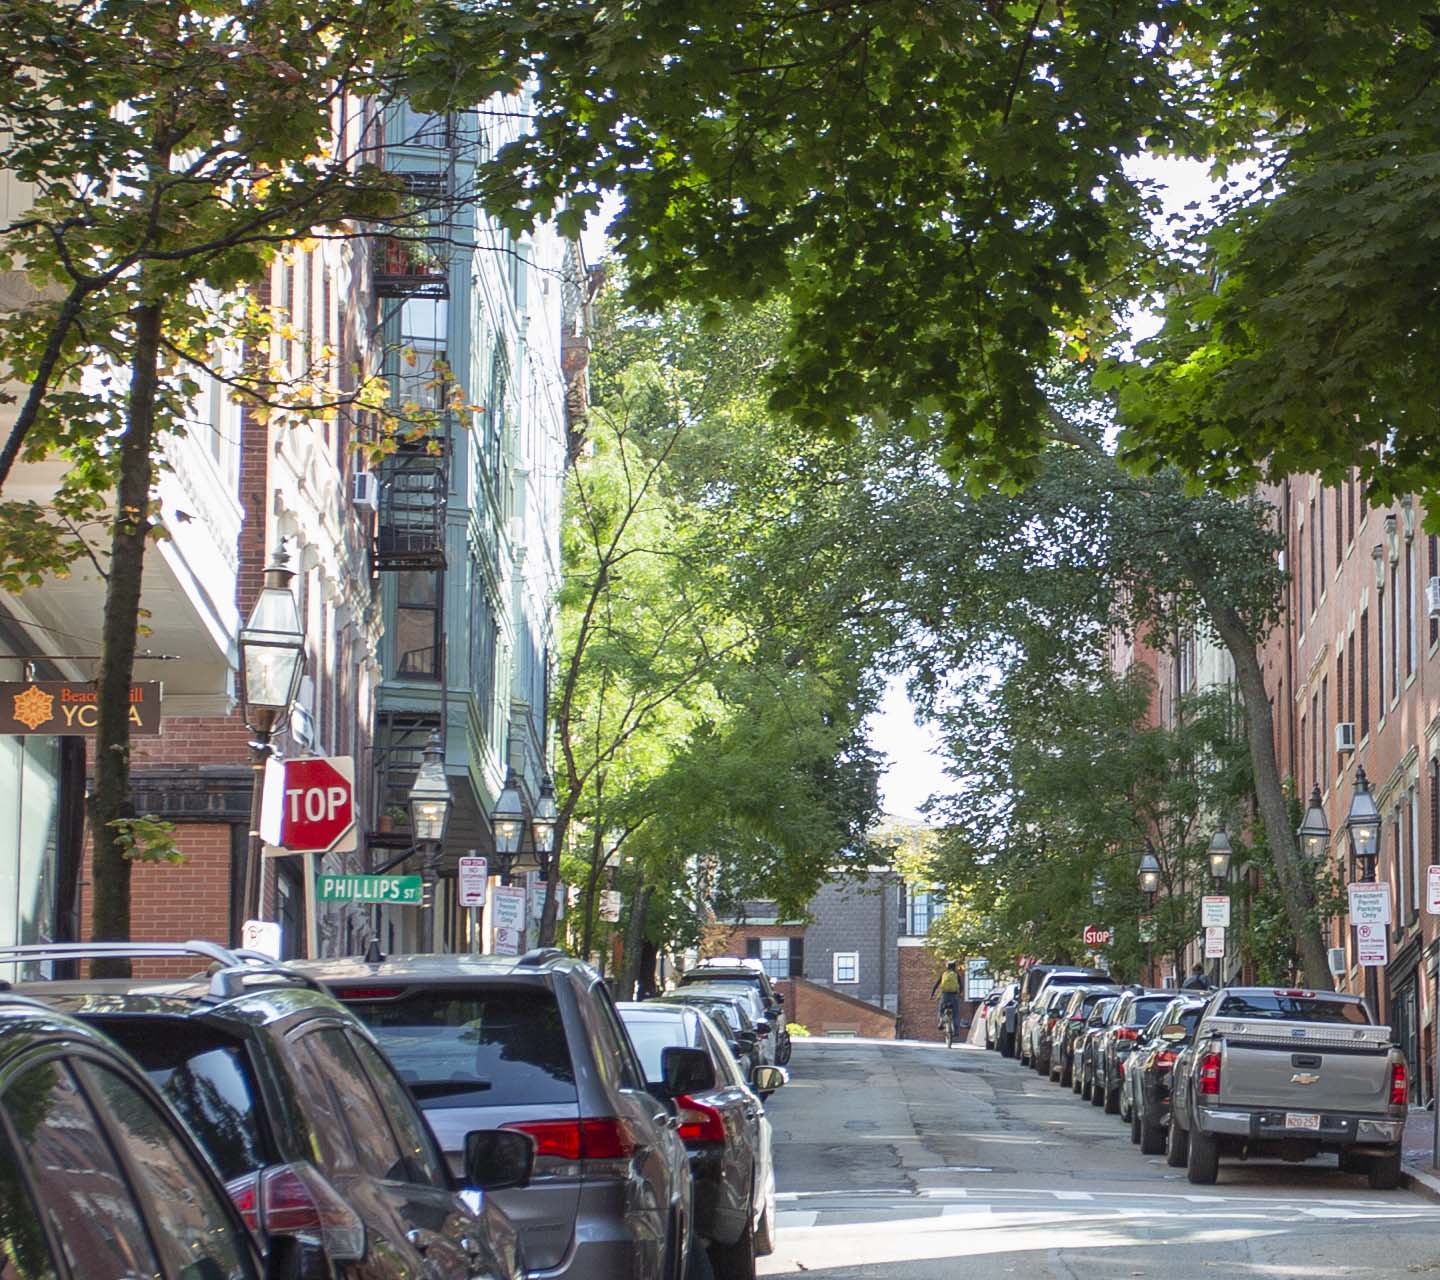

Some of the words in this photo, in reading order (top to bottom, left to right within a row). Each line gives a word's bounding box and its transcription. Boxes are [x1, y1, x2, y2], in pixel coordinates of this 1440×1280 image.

[61, 687, 97, 702] Beac
[128, 687, 143, 702] ill
[61, 704, 143, 728] YOA
[285, 786, 348, 823] TOP
[323, 879, 400, 900] PHILLIPS
[404, 888, 416, 900] ST
[1086, 931, 1110, 944] STOP
